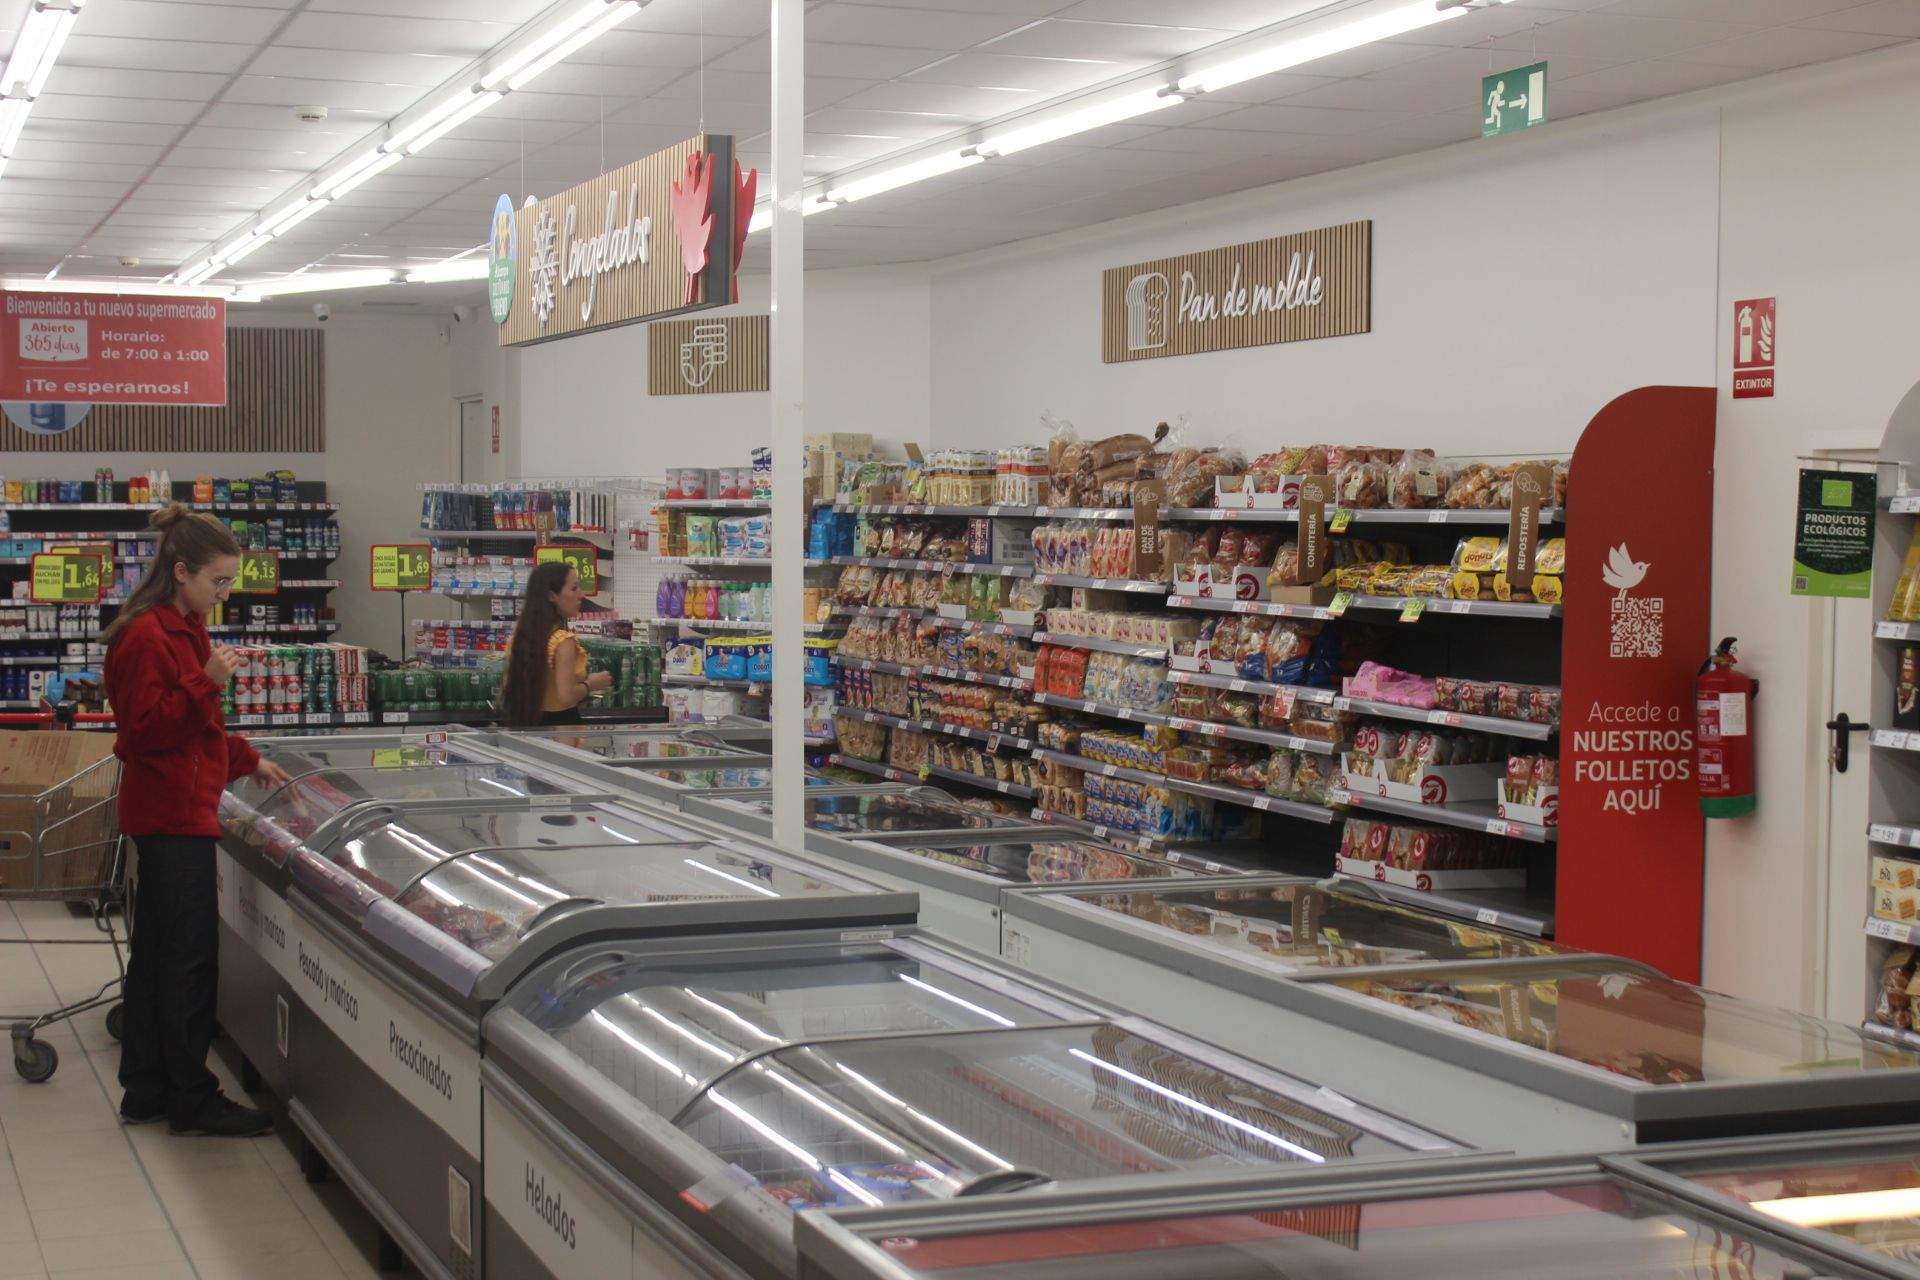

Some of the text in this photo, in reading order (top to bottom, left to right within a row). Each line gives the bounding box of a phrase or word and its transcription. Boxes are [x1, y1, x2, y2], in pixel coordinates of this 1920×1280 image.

[561, 183, 651, 321] Congelados
[1179, 250, 1323, 324] Pan de molde
[6, 295, 216, 321] Bienvenido a tu nuevo supermercado
[31, 322, 75, 333] Abierto
[101, 330, 165, 343] Horario:
[24, 335, 52, 351] 365
[101, 349, 209, 361] de 7:00 a 1:00
[26, 379, 189, 396] ¡Te esperamos!
[1735, 377, 1772, 389] EXTINTOR
[1141, 525, 1148, 536] DE
[1803, 524, 1867, 537] ECOLÓGICOS
[1805, 513, 1867, 526] PRODUCTOS
[1307, 513, 1316, 568] CONFITERÍA
[1517, 506, 1530, 570] REPOSTERÍA
[1588, 701, 1679, 722] Accede a
[1573, 730, 1693, 752] NUESTROS
[1575, 759, 1690, 782] FOLLETOS
[1602, 783, 1662, 815] AQUÍ
[298, 941, 324, 990] Pescado
[330, 977, 359, 1021] marisco
[388, 1019, 453, 1101] Precocinados
[525, 1161, 577, 1250] Helados
